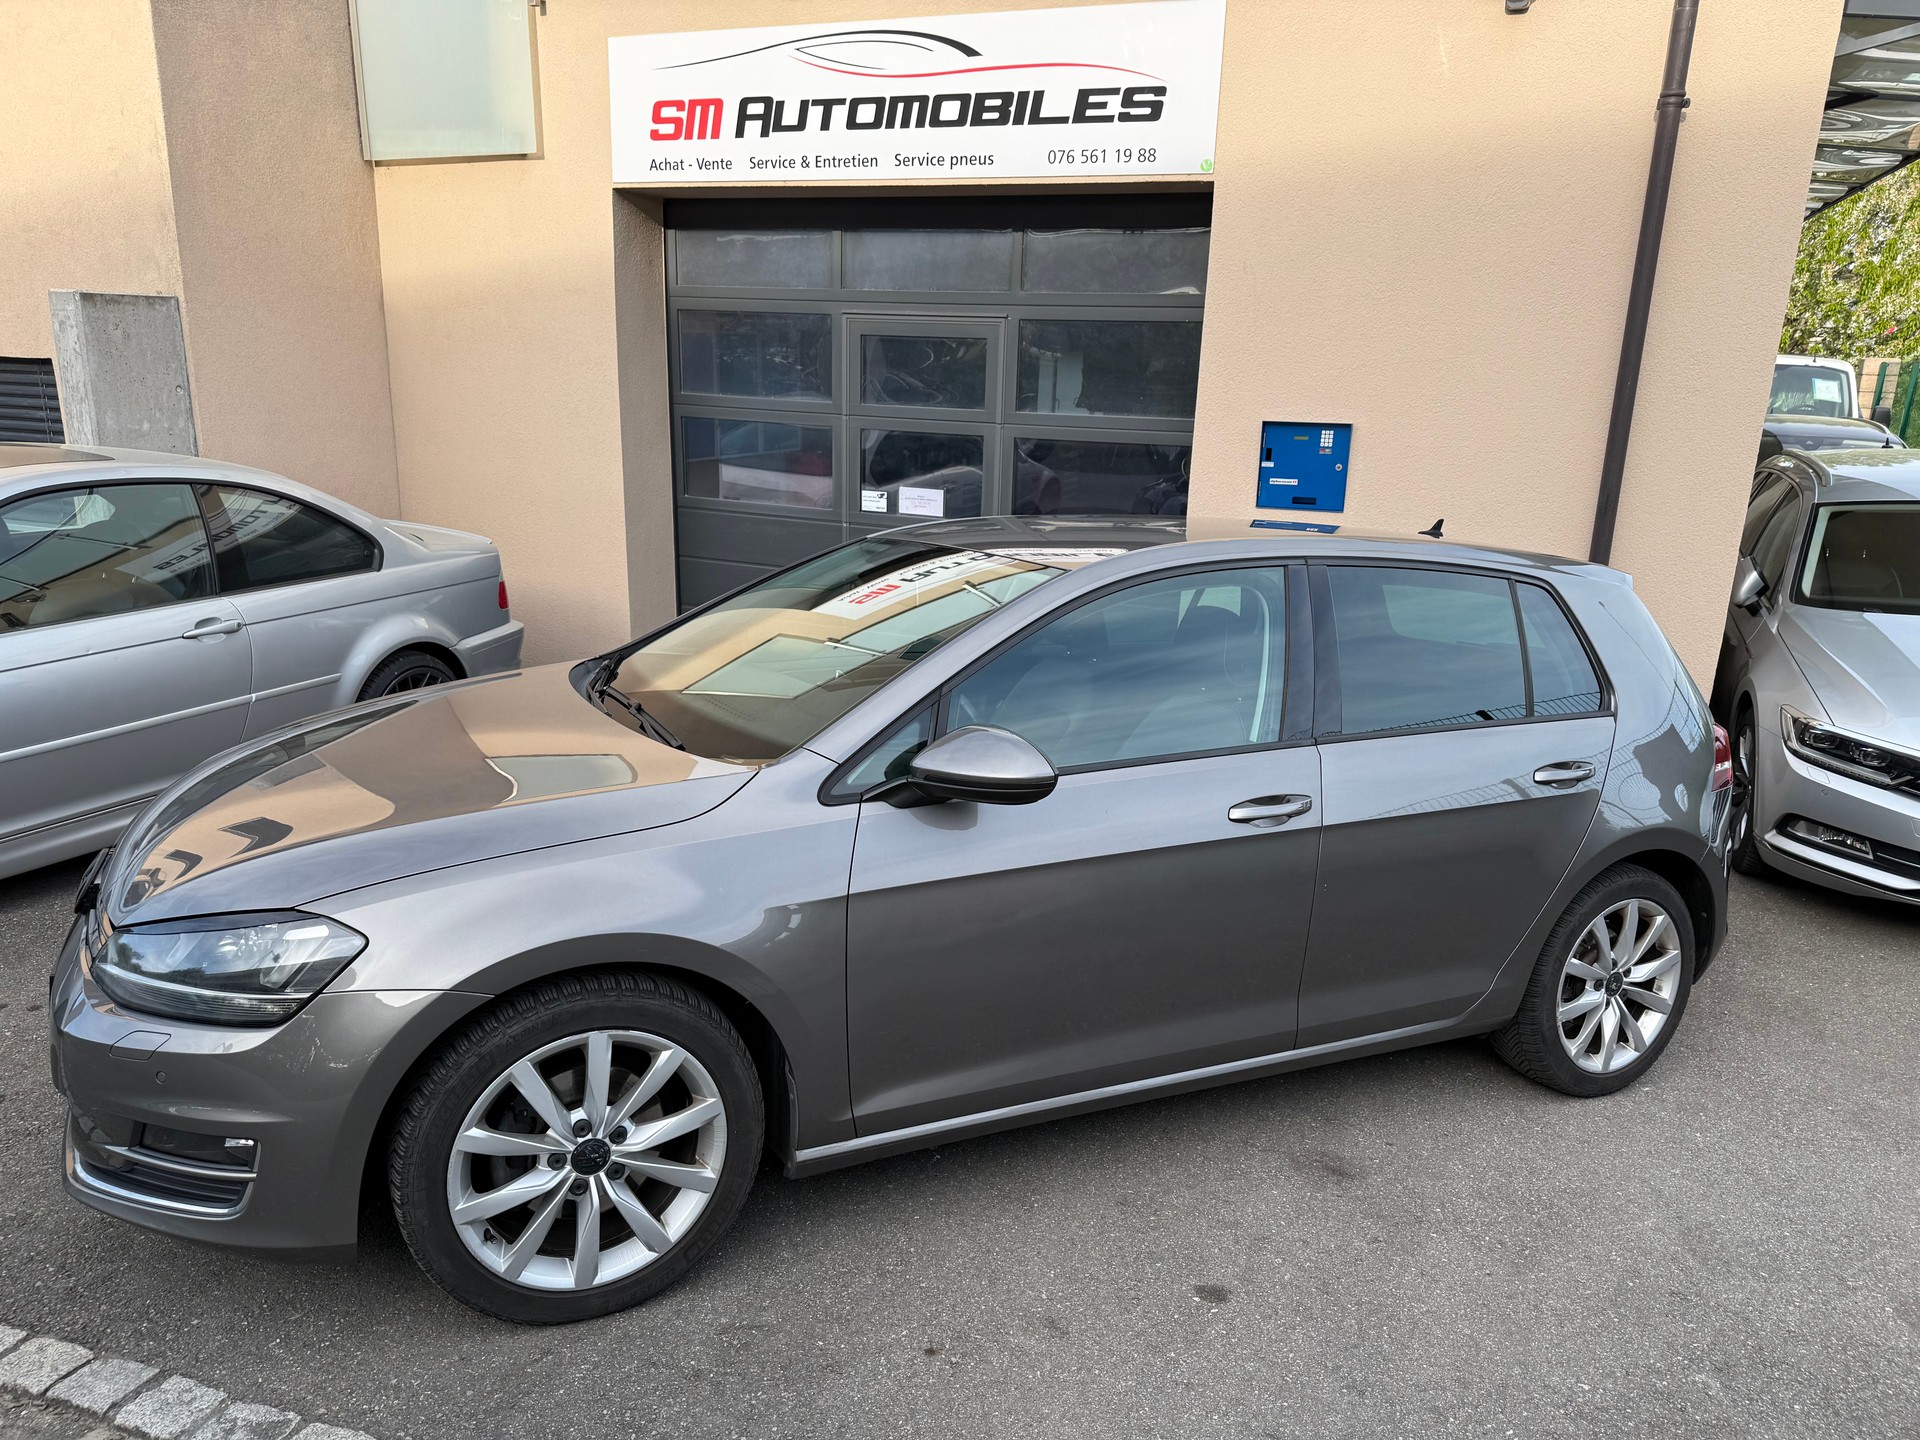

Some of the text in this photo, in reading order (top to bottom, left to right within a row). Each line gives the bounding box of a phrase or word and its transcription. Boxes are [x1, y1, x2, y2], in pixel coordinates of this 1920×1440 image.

[650, 86, 1167, 141] SM AUTOMOBILES
[750, 154, 877, 169] Service & Entretien
[895, 153, 993, 169] Service pneus
[1048, 148, 1156, 164] 076 561 19 88
[650, 158, 684, 171] Achat
[697, 158, 732, 170] Vente
